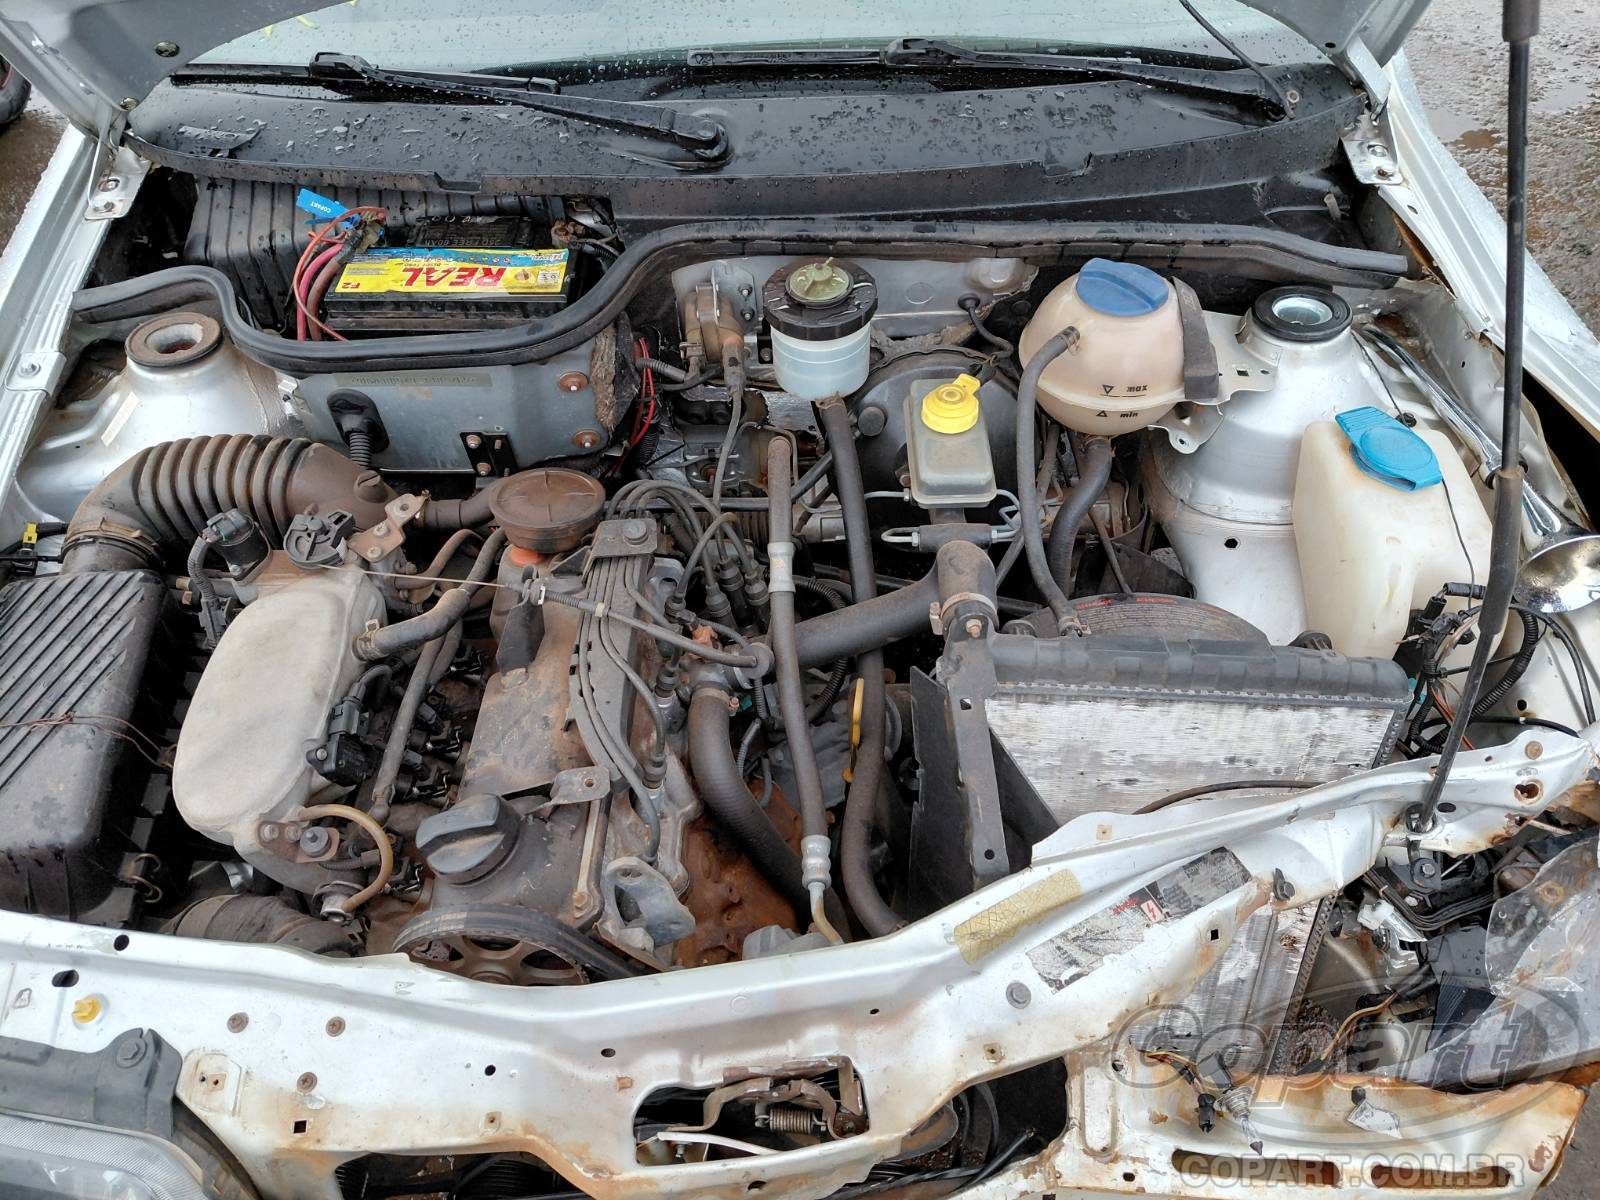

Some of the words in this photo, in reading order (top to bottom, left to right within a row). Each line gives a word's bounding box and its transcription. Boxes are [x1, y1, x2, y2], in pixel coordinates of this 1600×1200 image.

[310, 200, 332, 214] COPART
[402, 266, 506, 286] REAL
[1126, 384, 1148, 393] max
